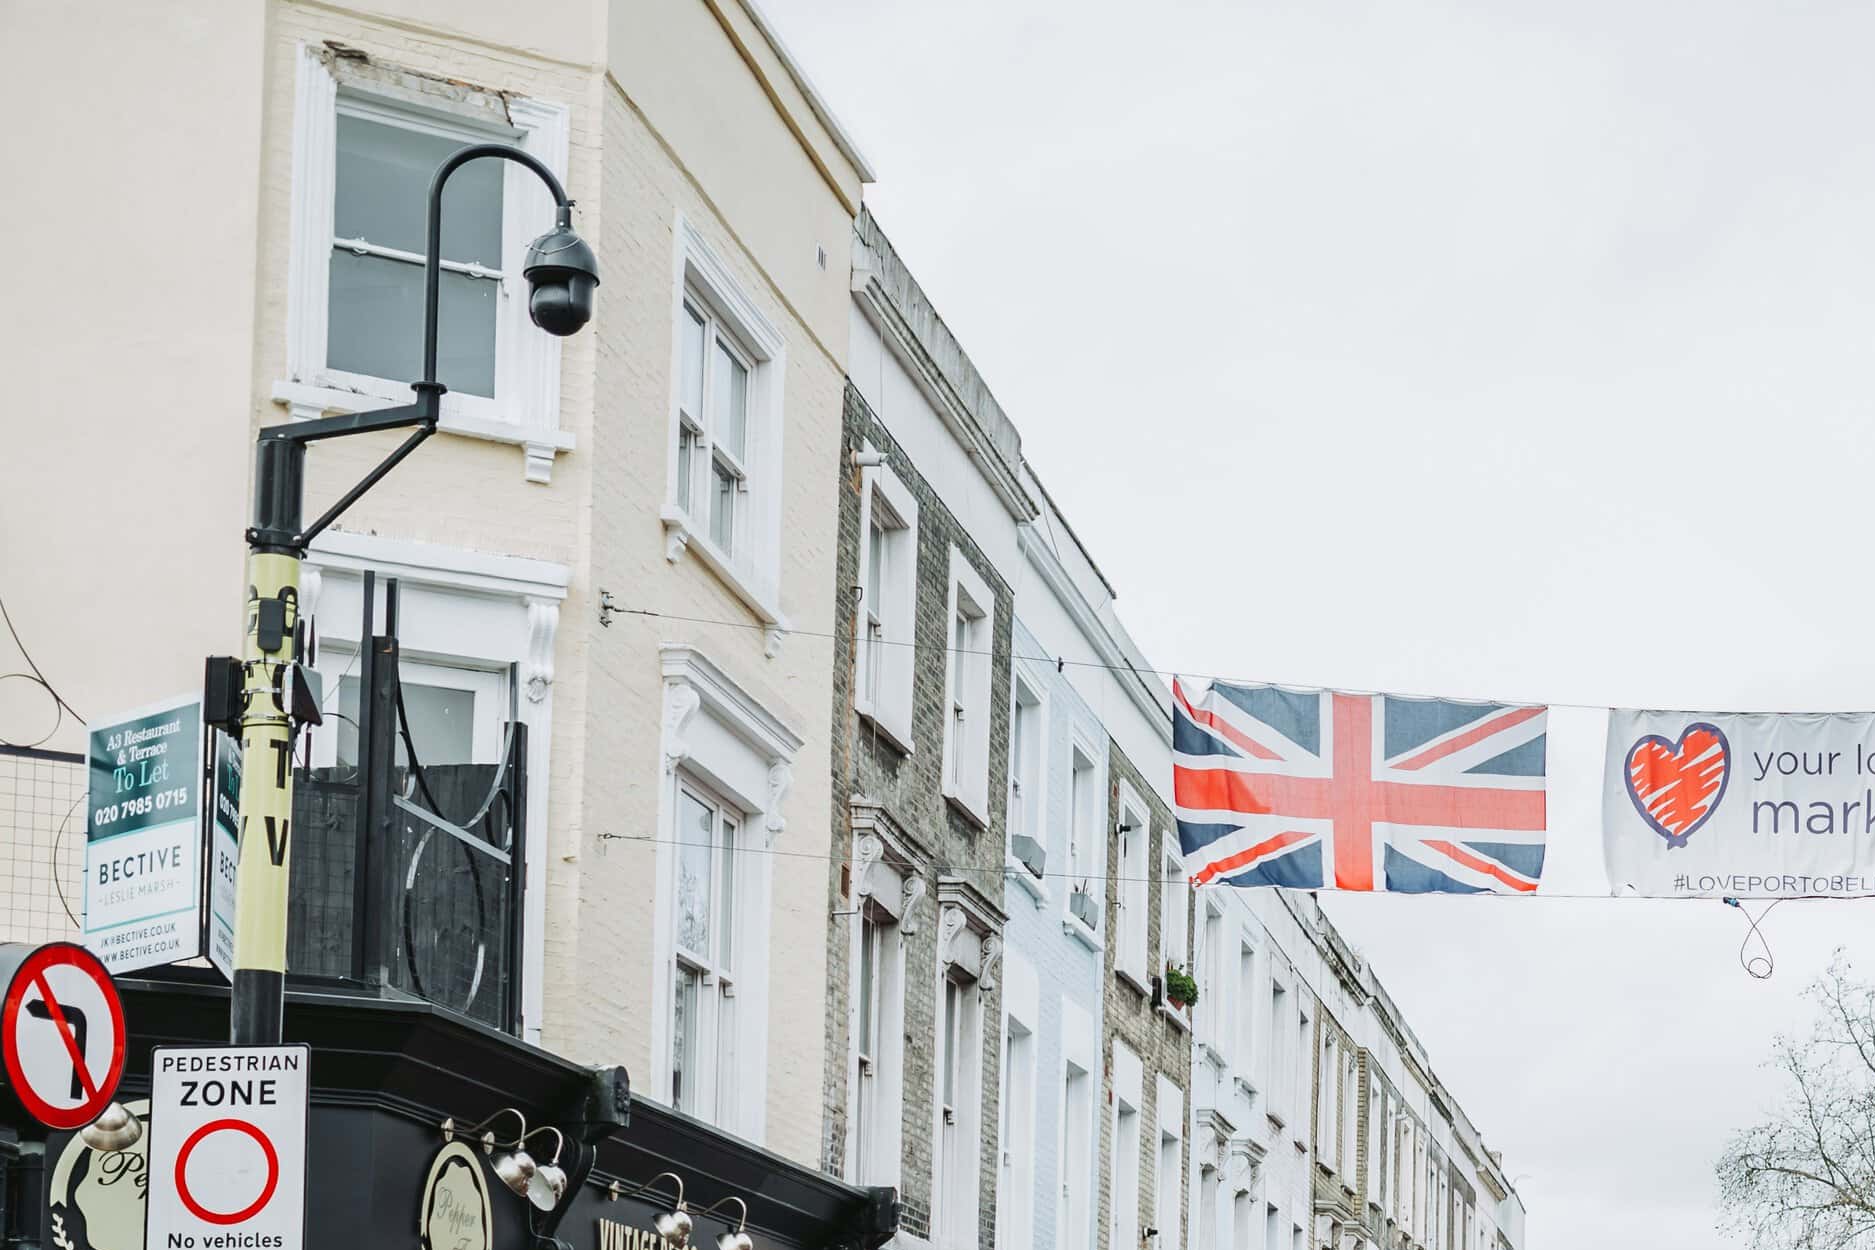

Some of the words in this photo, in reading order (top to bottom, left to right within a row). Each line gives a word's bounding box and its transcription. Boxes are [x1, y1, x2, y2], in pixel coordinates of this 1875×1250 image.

[106, 734, 122, 751] A3
[123, 720, 181, 746] Restaurant
[117, 749, 126, 766] &
[129, 742, 168, 762] Terrace
[1753, 751, 1842, 781] your
[113, 766, 134, 793] To
[139, 759, 169, 787] Let
[95, 805, 118, 826] 020
[121, 795, 152, 818] 7985
[156, 787, 187, 809] 0715
[100, 845, 181, 885] BECTIVE
[162, 1055, 298, 1072] PEDESTRIAN
[180, 1080, 277, 1106] ZONE
[437, 1186, 476, 1234] Pepper
[167, 1233, 194, 1249] No
[203, 1232, 283, 1248] vehicles
